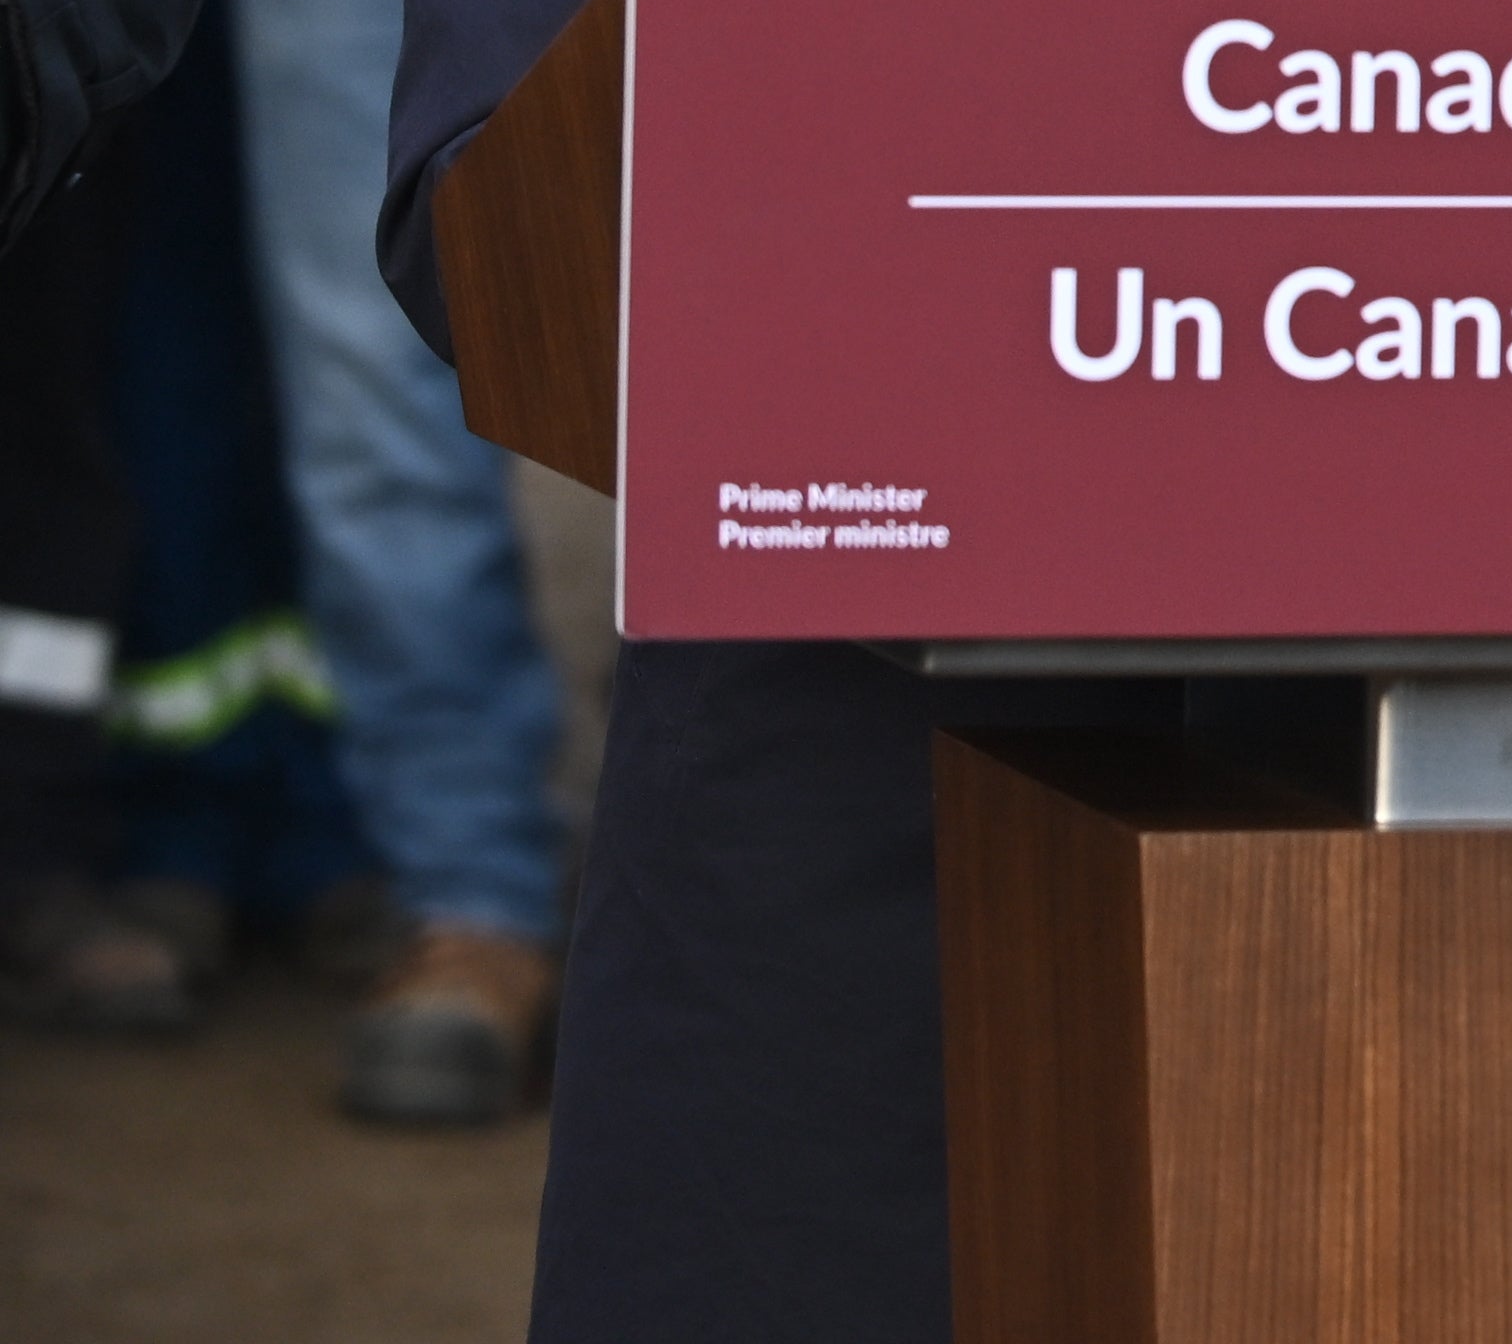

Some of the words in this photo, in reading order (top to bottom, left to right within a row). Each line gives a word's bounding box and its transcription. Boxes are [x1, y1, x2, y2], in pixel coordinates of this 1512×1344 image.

[1050, 267, 1223, 382] Un
[719, 482, 803, 512] Prime
[808, 482, 928, 512] Minister
[718, 518, 831, 549] Premier
[834, 518, 950, 549] ministre
